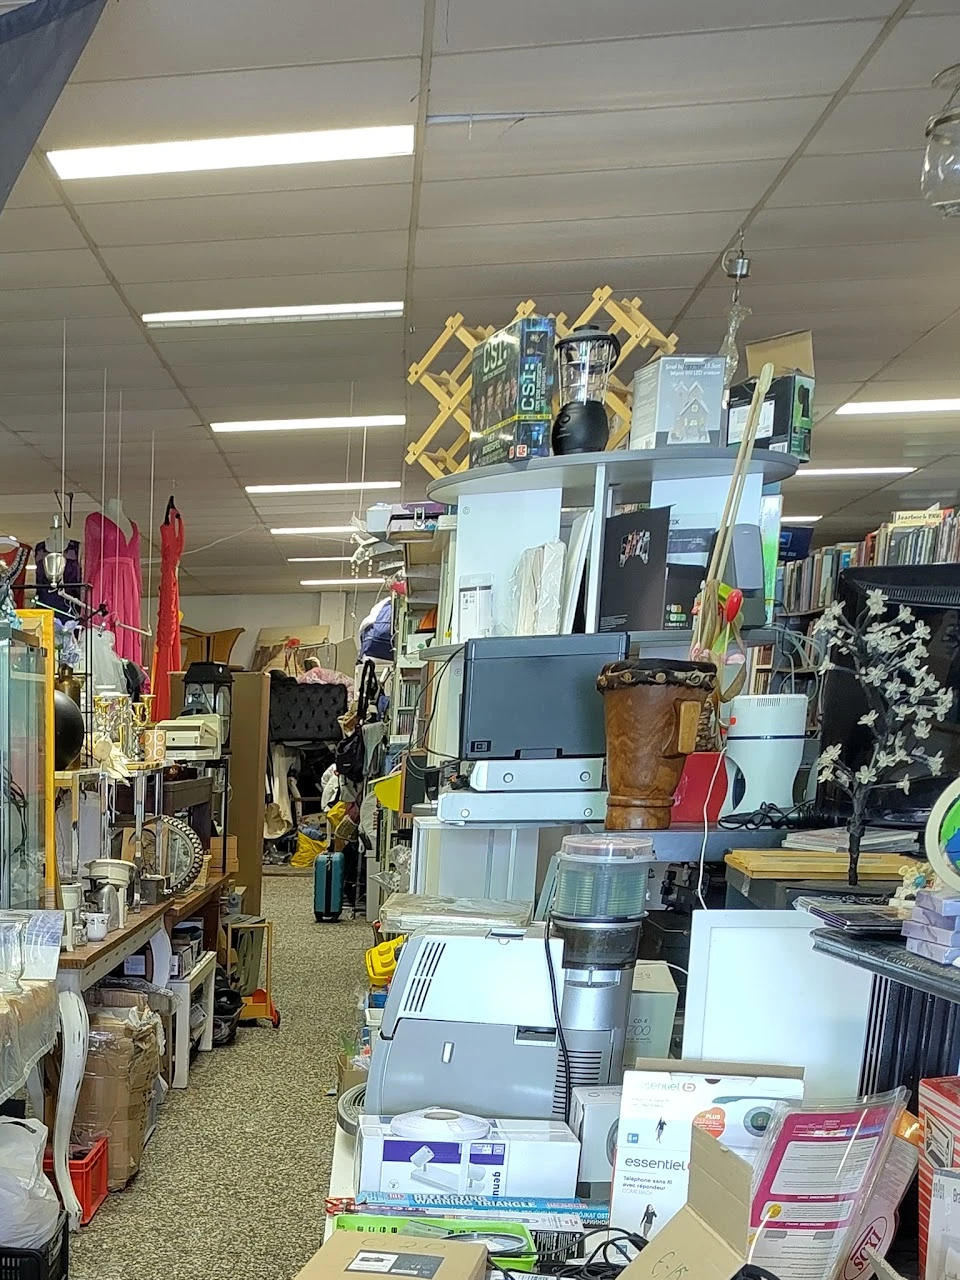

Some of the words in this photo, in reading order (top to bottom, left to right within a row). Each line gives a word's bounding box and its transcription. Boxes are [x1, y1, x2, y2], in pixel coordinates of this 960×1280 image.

[521, 363, 536, 411] CSI:
[625, 1158, 686, 1171] essentiel
[414, 1199, 476, 1207] WARNING
